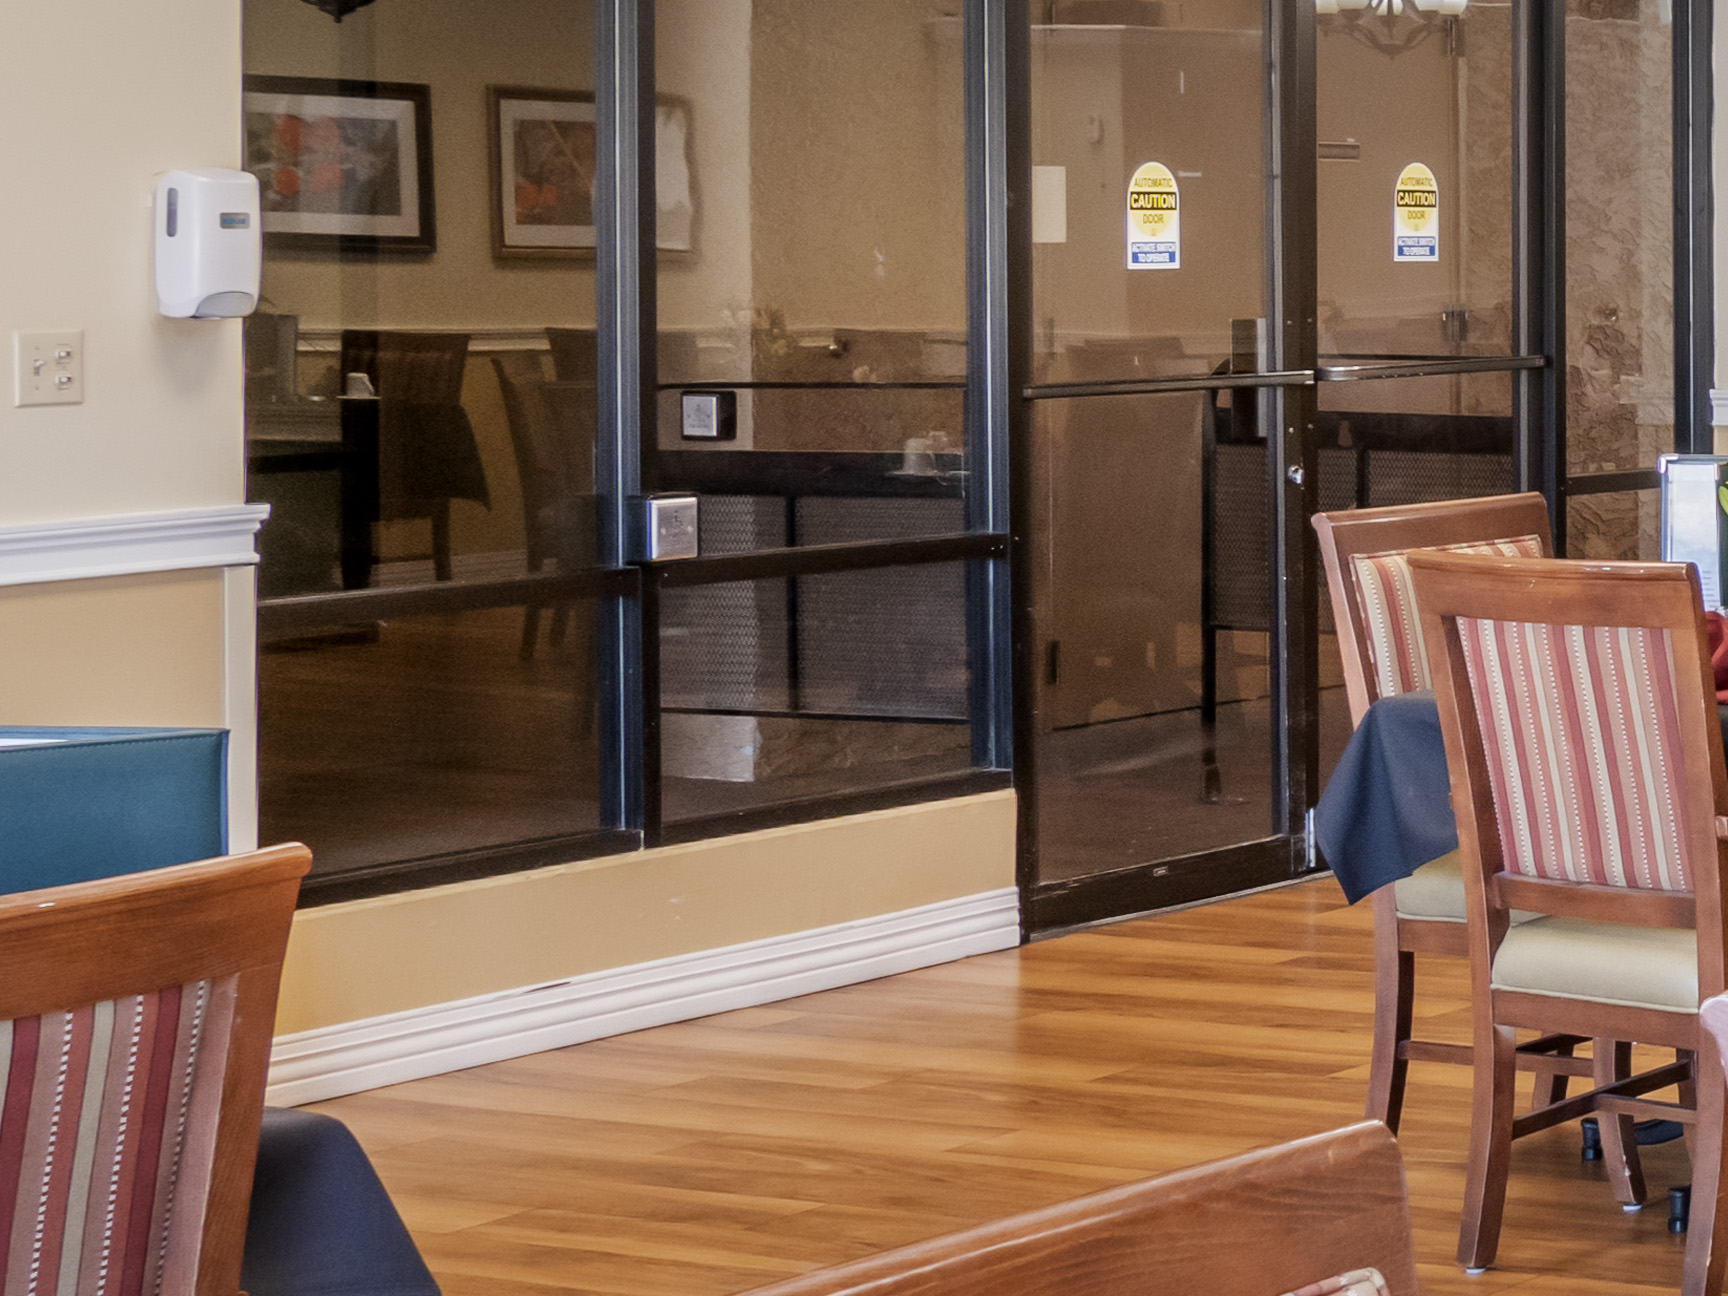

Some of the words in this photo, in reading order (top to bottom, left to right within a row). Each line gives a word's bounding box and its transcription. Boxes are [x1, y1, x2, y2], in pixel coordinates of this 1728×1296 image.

[1134, 177, 1174, 188] AUTOMATIC
[1400, 177, 1434, 187] AUTOMATIC
[1131, 193, 1176, 209] CAUTION
[1397, 191, 1436, 206] CAUTION
[1142, 213, 1165, 224] DOOR
[1407, 210, 1426, 220] DOOR
